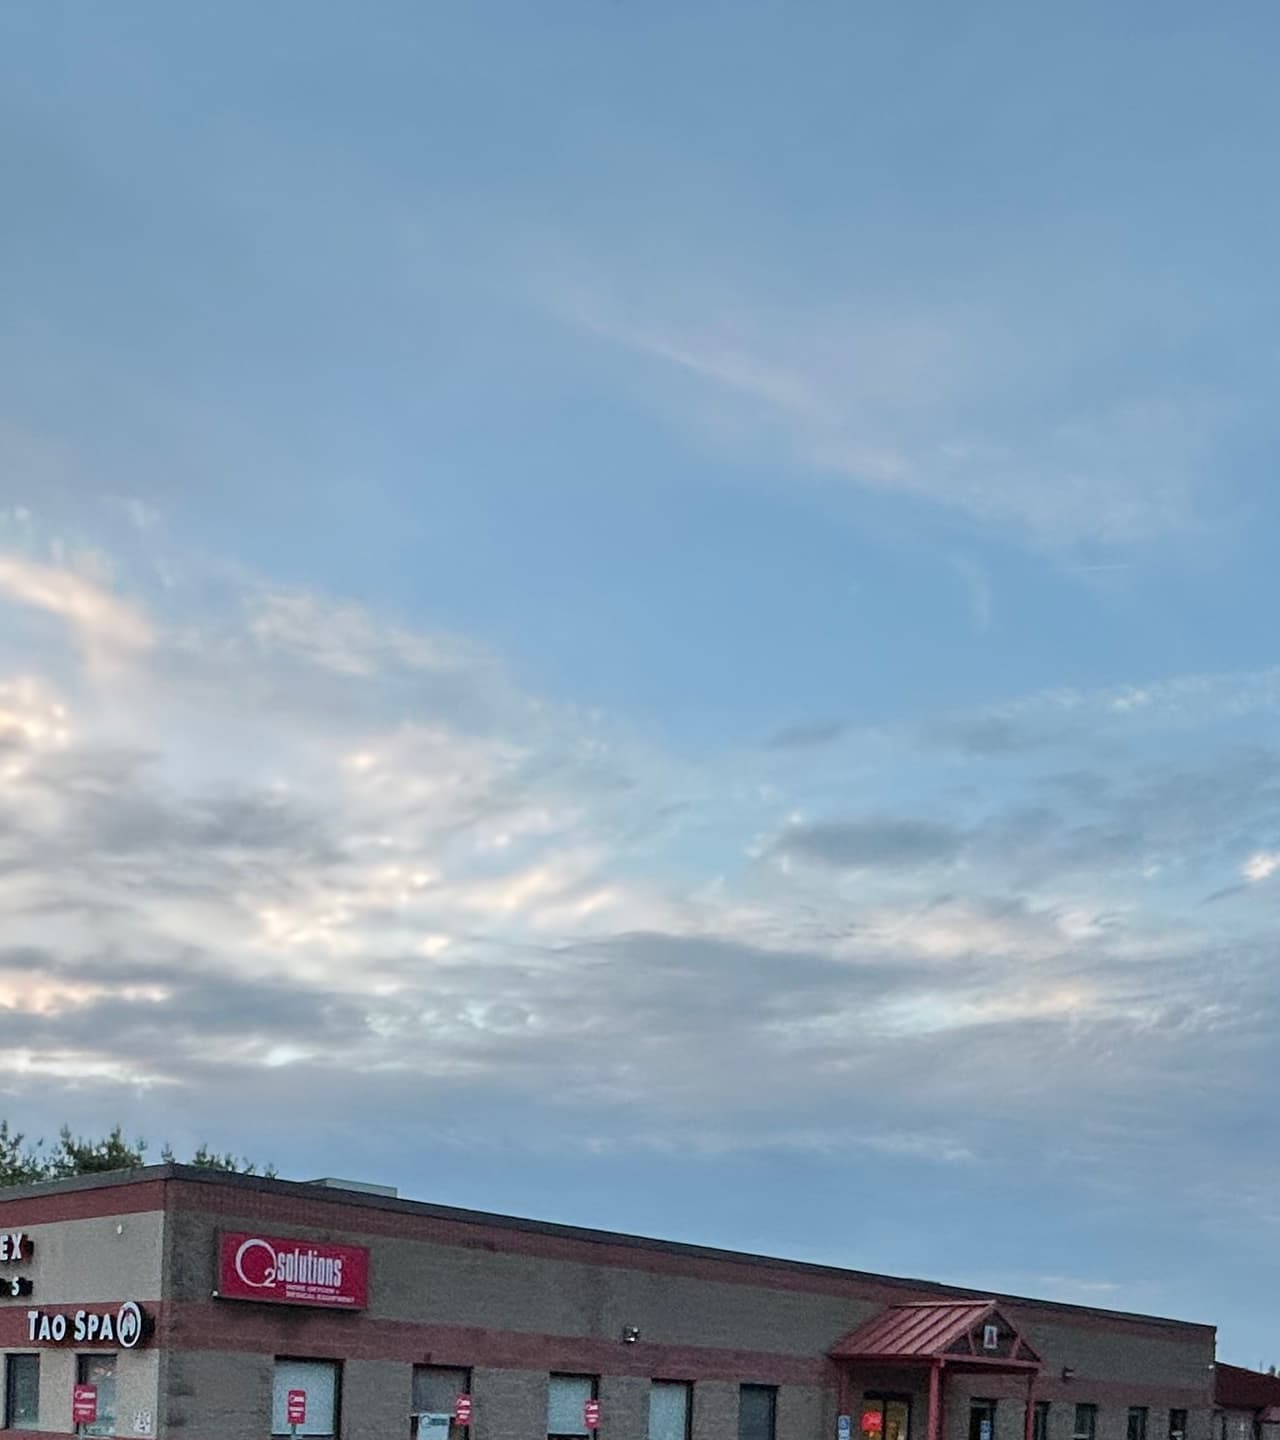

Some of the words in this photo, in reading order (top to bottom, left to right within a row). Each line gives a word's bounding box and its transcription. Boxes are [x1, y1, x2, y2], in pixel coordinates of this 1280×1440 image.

[277, 1248, 342, 1288] solutions
[28, 1310, 66, 1341] TAO
[74, 1310, 113, 1341] SPA
